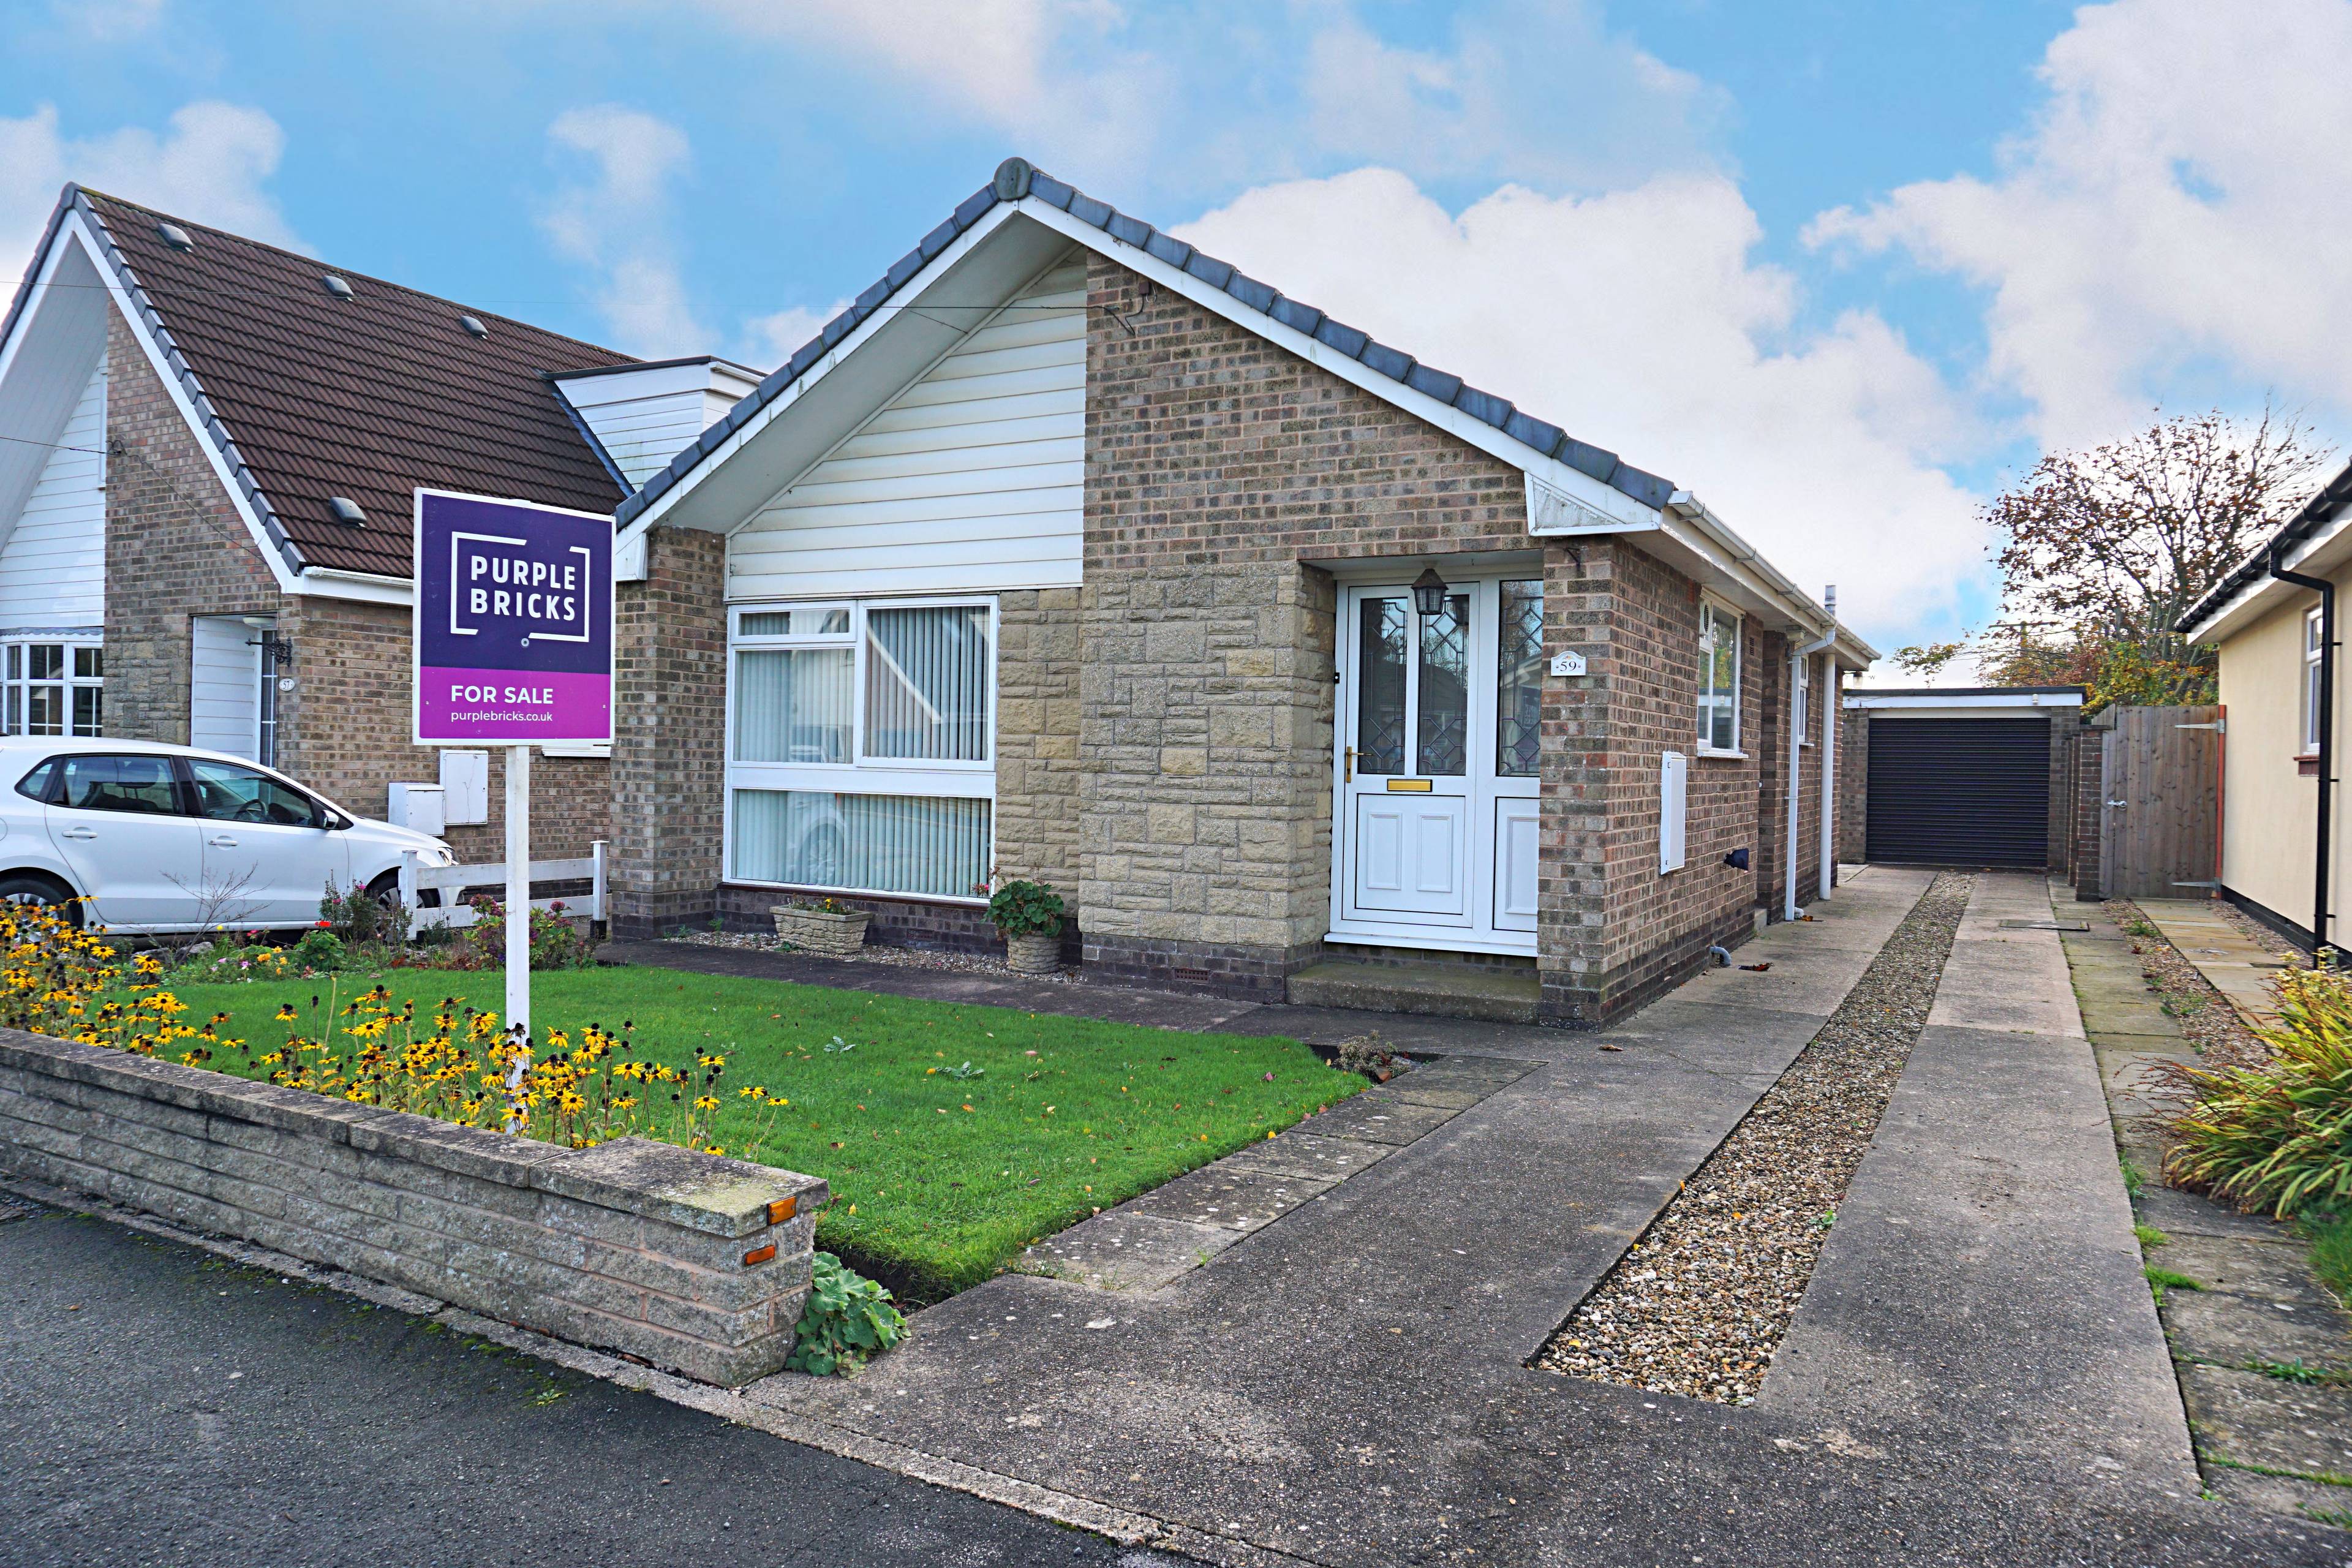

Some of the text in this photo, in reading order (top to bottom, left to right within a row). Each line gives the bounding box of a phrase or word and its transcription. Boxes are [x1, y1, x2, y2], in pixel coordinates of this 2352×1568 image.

[471, 555, 575, 590] PURPLE
[470, 588, 575, 621] BRICKS
[1559, 661, 1577, 671] 59
[283, 680, 290, 690] 57
[451, 685, 554, 704] FOR SALE
[451, 710, 553, 722] purplebricks.co.uk
